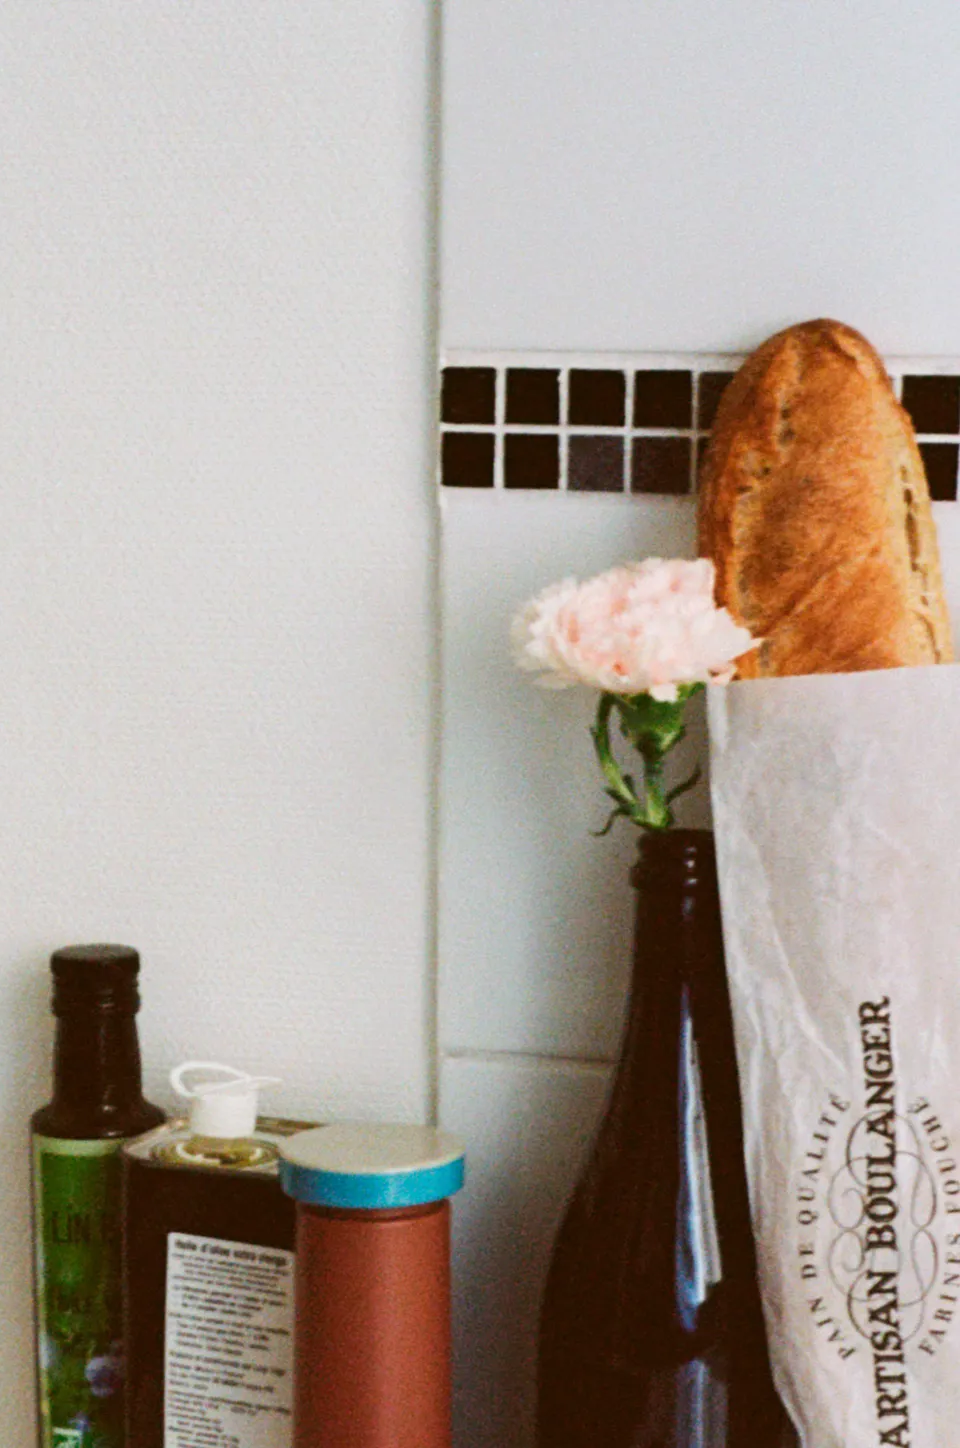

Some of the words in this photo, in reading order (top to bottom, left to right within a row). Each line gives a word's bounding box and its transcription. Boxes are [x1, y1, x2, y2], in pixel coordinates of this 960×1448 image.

[796, 1092, 851, 1226] QUALITÉ
[858, 995, 899, 1252] BOULANGER
[907, 1096, 960, 1216] FOUCHÉ
[797, 1242, 818, 1281] DE
[809, 1296, 857, 1361] PAIN
